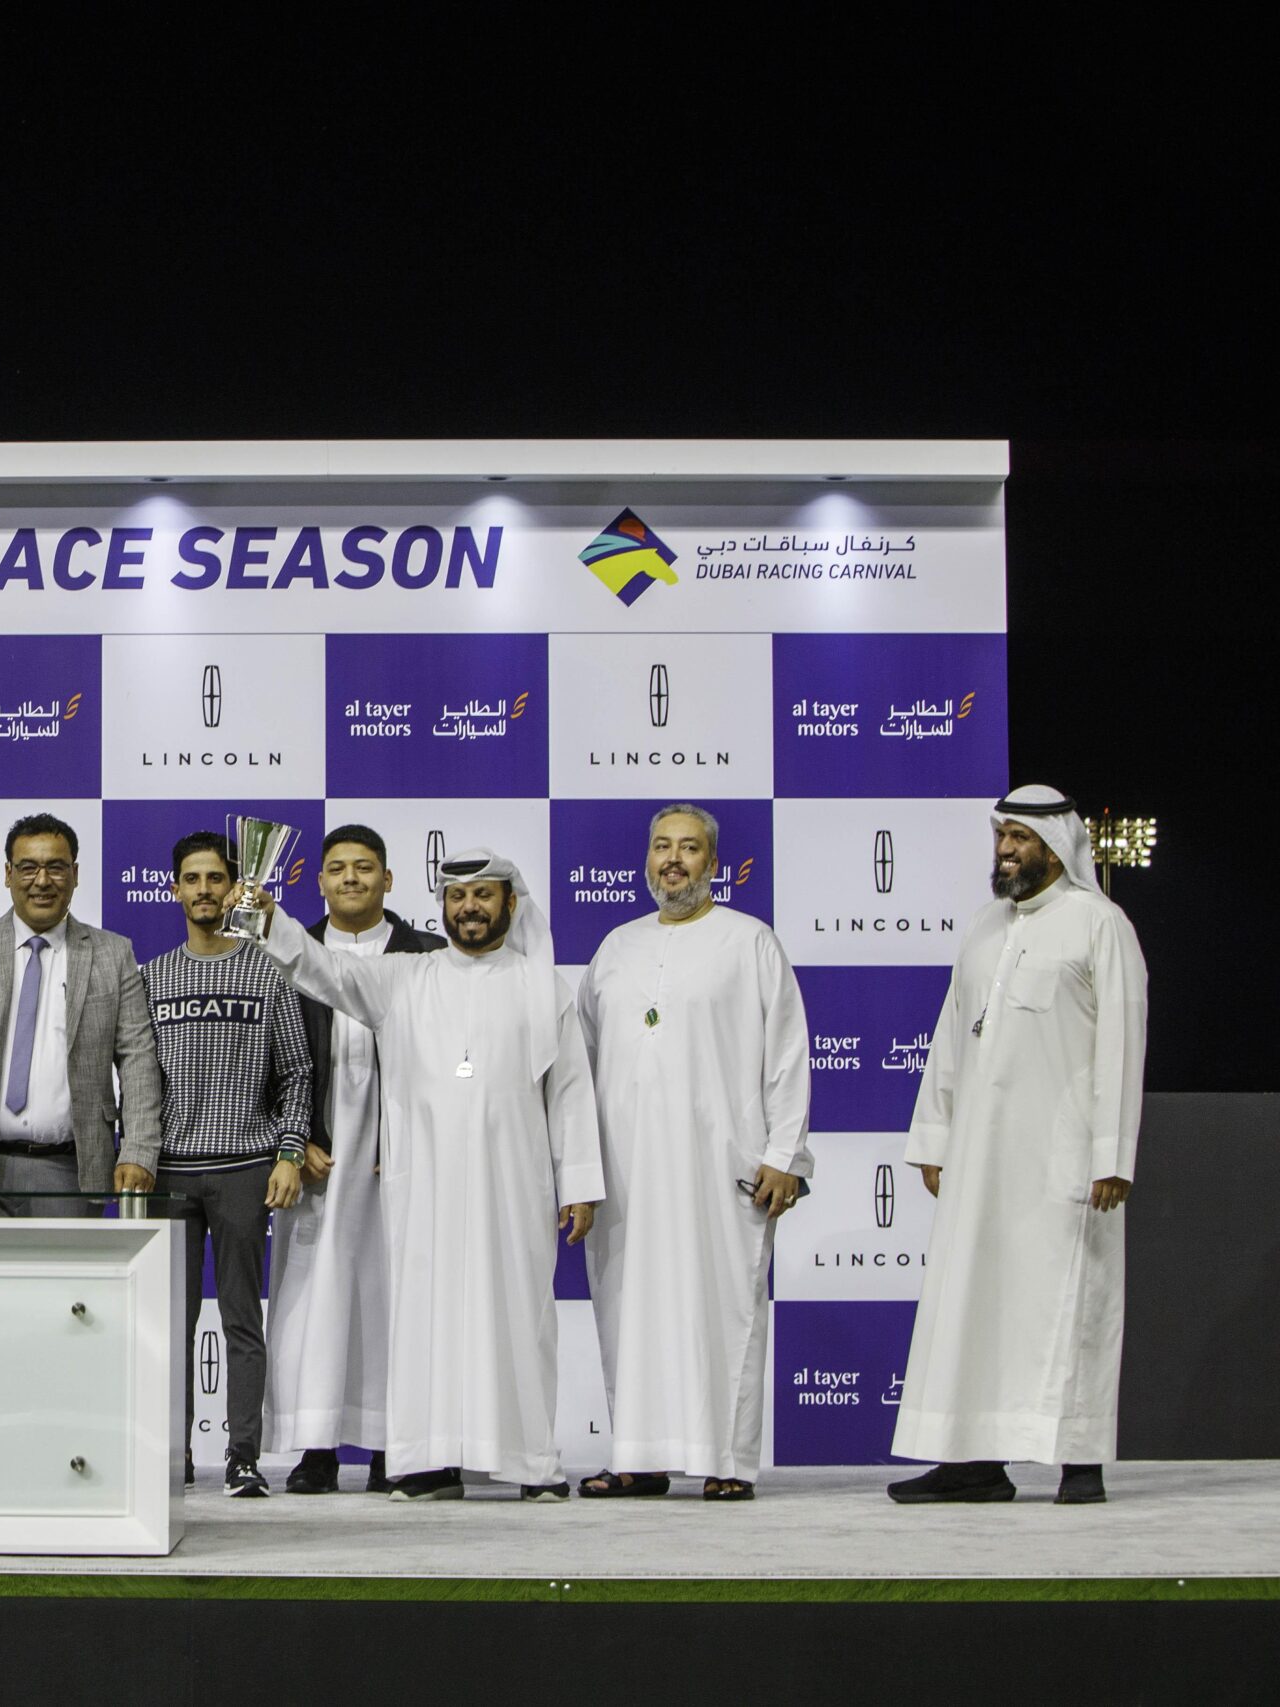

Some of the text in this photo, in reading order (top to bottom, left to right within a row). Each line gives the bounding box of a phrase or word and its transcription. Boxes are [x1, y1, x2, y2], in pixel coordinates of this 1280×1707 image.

[169, 524, 504, 591] SEASON
[696, 534, 916, 561] كرنفال سباقات دبي
[695, 563, 917, 580] DUBAI RACING CARNIVAL
[345, 700, 412, 720] al tayer
[792, 700, 859, 720] al tayer
[350, 721, 412, 737] motors
[432, 719, 506, 741] للسيارات
[797, 721, 859, 737] motors
[879, 719, 953, 741] للسيارات
[142, 752, 282, 766] LINCOLN
[590, 752, 729, 766] LINCOLN
[121, 865, 136, 883] al
[569, 865, 636, 887] al tayer
[575, 887, 636, 903] motors
[814, 918, 954, 932] LINCOLN
[157, 999, 261, 1022] BUGATTI
[815, 1034, 861, 1054] tayer
[793, 1367, 808, 1385] al
[814, 1369, 860, 1389] tayer
[798, 1389, 860, 1405] motors
